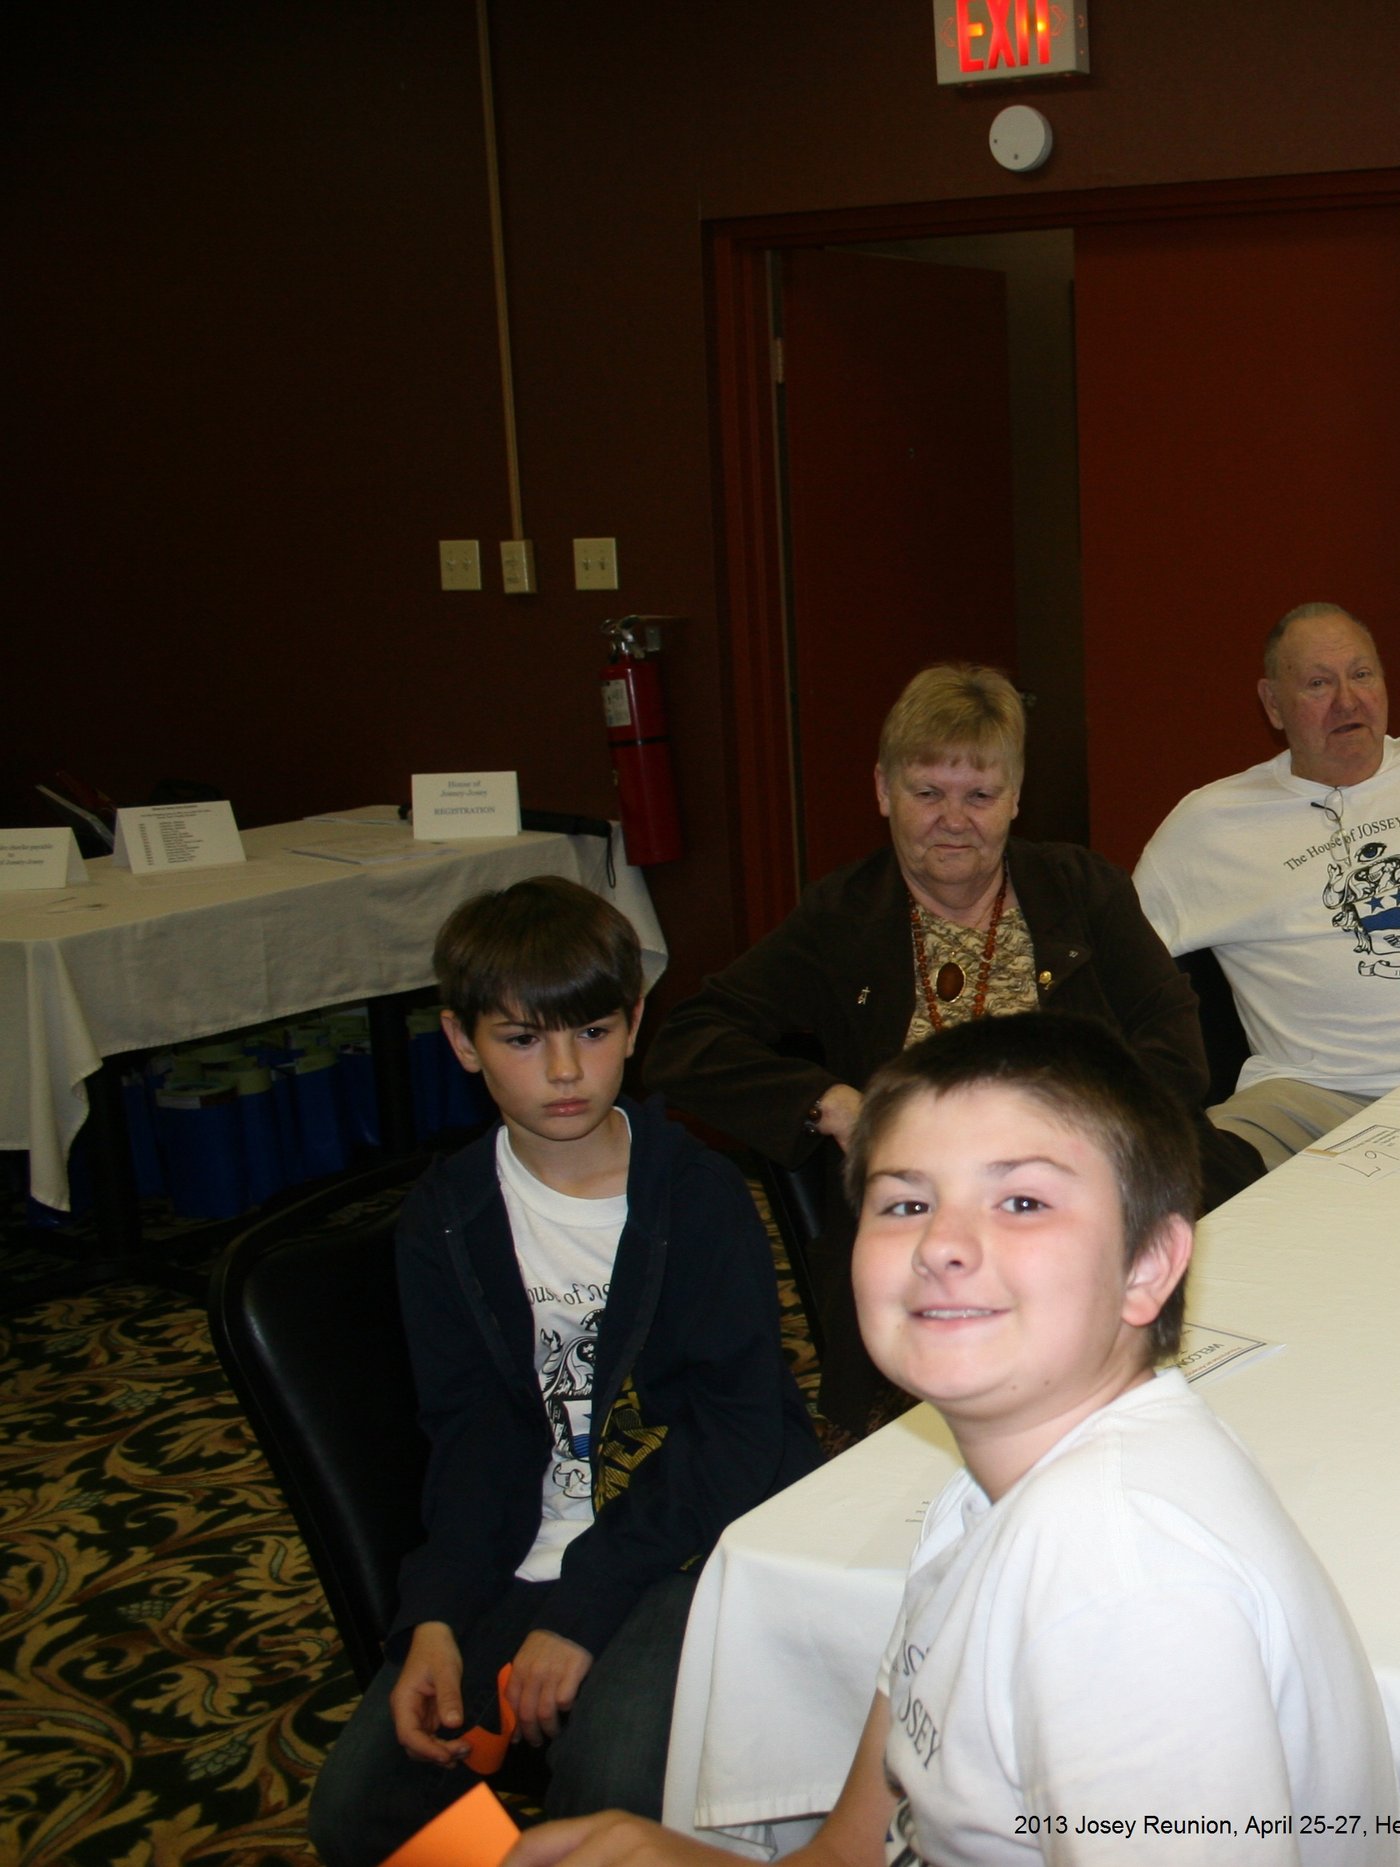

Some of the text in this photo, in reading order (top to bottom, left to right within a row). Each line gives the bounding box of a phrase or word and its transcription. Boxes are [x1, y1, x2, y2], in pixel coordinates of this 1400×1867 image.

[434, 806, 496, 815] REGISTRATION
[1283, 853, 1308, 872] The
[1306, 835, 1343, 859] House
[1343, 829, 1356, 844] of
[563, 1282, 584, 1306] of
[1175, 1342, 1225, 1369] WELCOM
